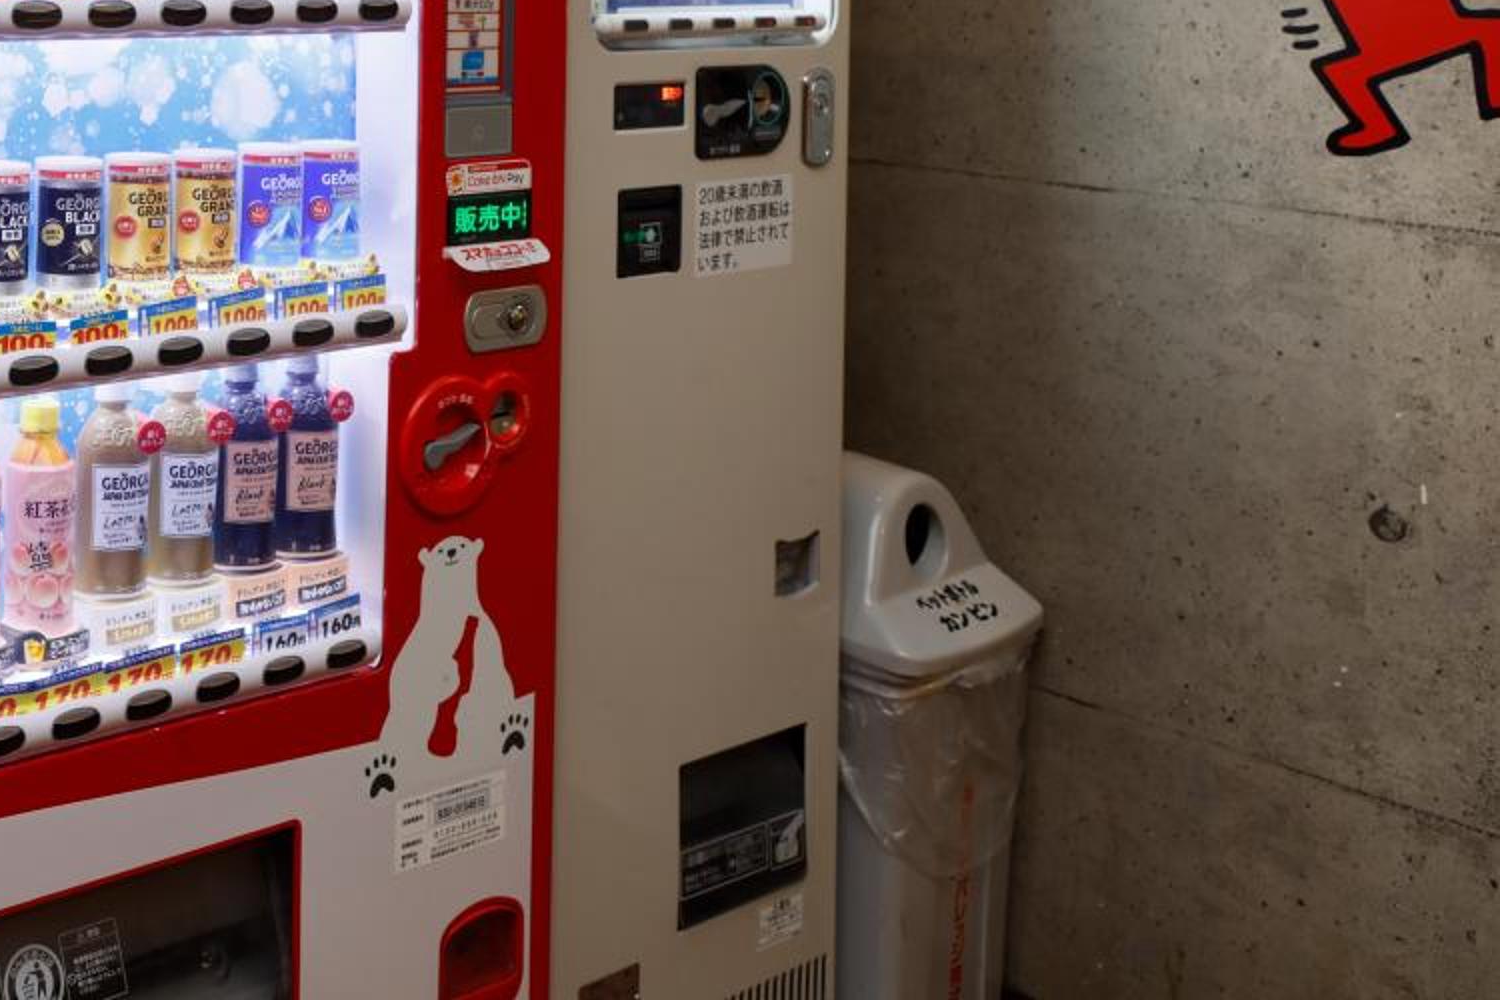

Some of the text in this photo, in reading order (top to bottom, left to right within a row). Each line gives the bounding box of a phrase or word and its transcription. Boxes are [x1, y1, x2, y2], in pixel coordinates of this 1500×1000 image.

[699, 179, 784, 206] 20歳未満の飲酒
[699, 201, 790, 228] および飲酒運転は
[699, 222, 790, 250] 法律で禁止されて
[320, 612, 360, 638] 160円
